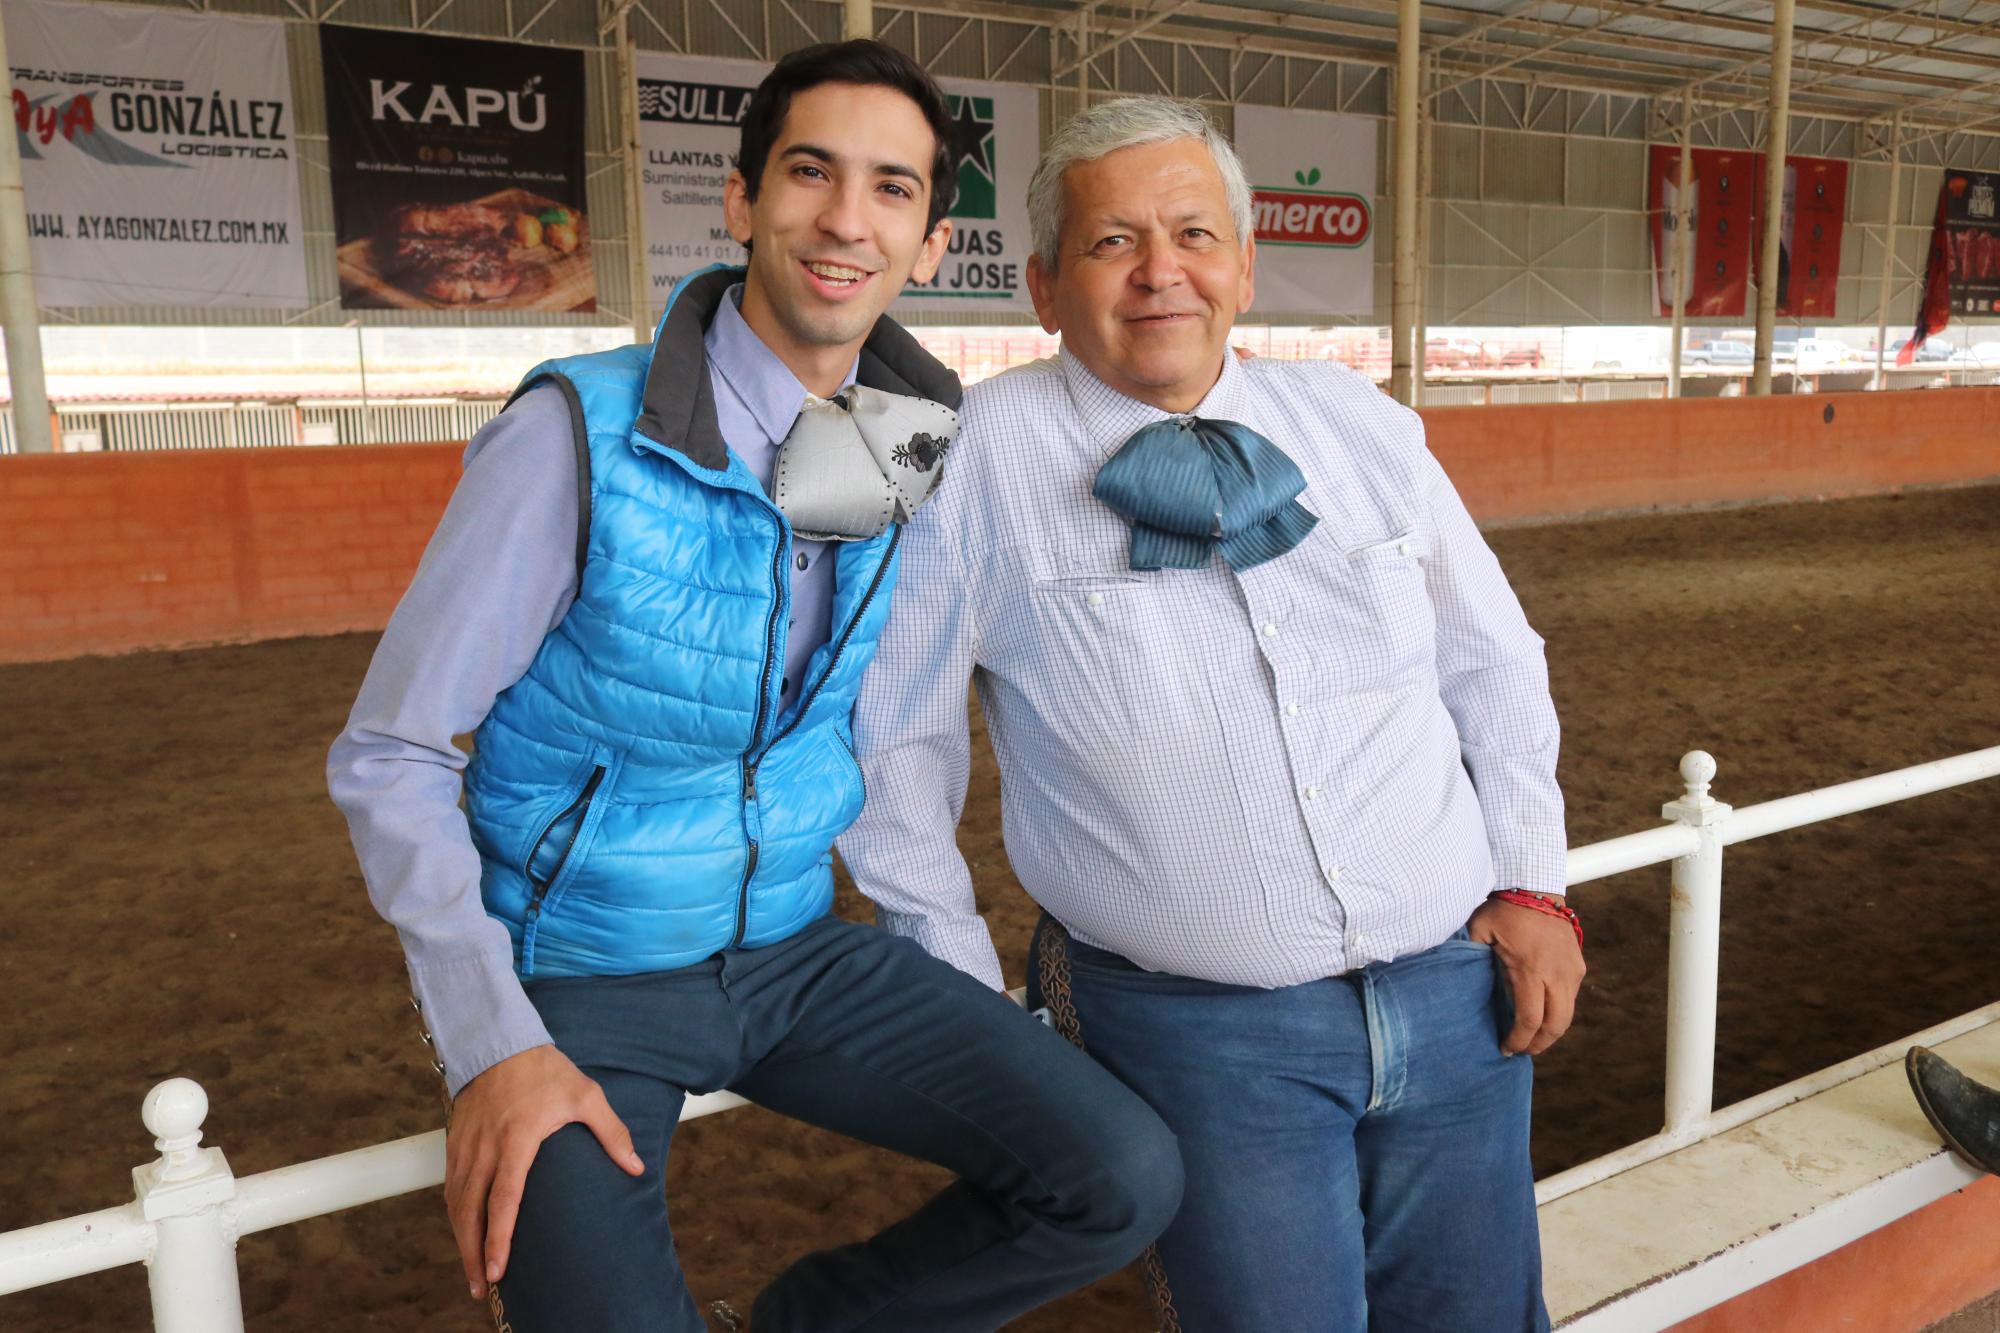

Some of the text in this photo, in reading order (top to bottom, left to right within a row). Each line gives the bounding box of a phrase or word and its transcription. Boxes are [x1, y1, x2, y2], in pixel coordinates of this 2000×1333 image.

[110, 90, 287, 140] GONZÁLEZ
[161, 143, 289, 159] LOGISTICA
[650, 151, 723, 168] LLANTAS
[27, 214, 70, 239] WW.
[950, 264, 1017, 289] JOSE
